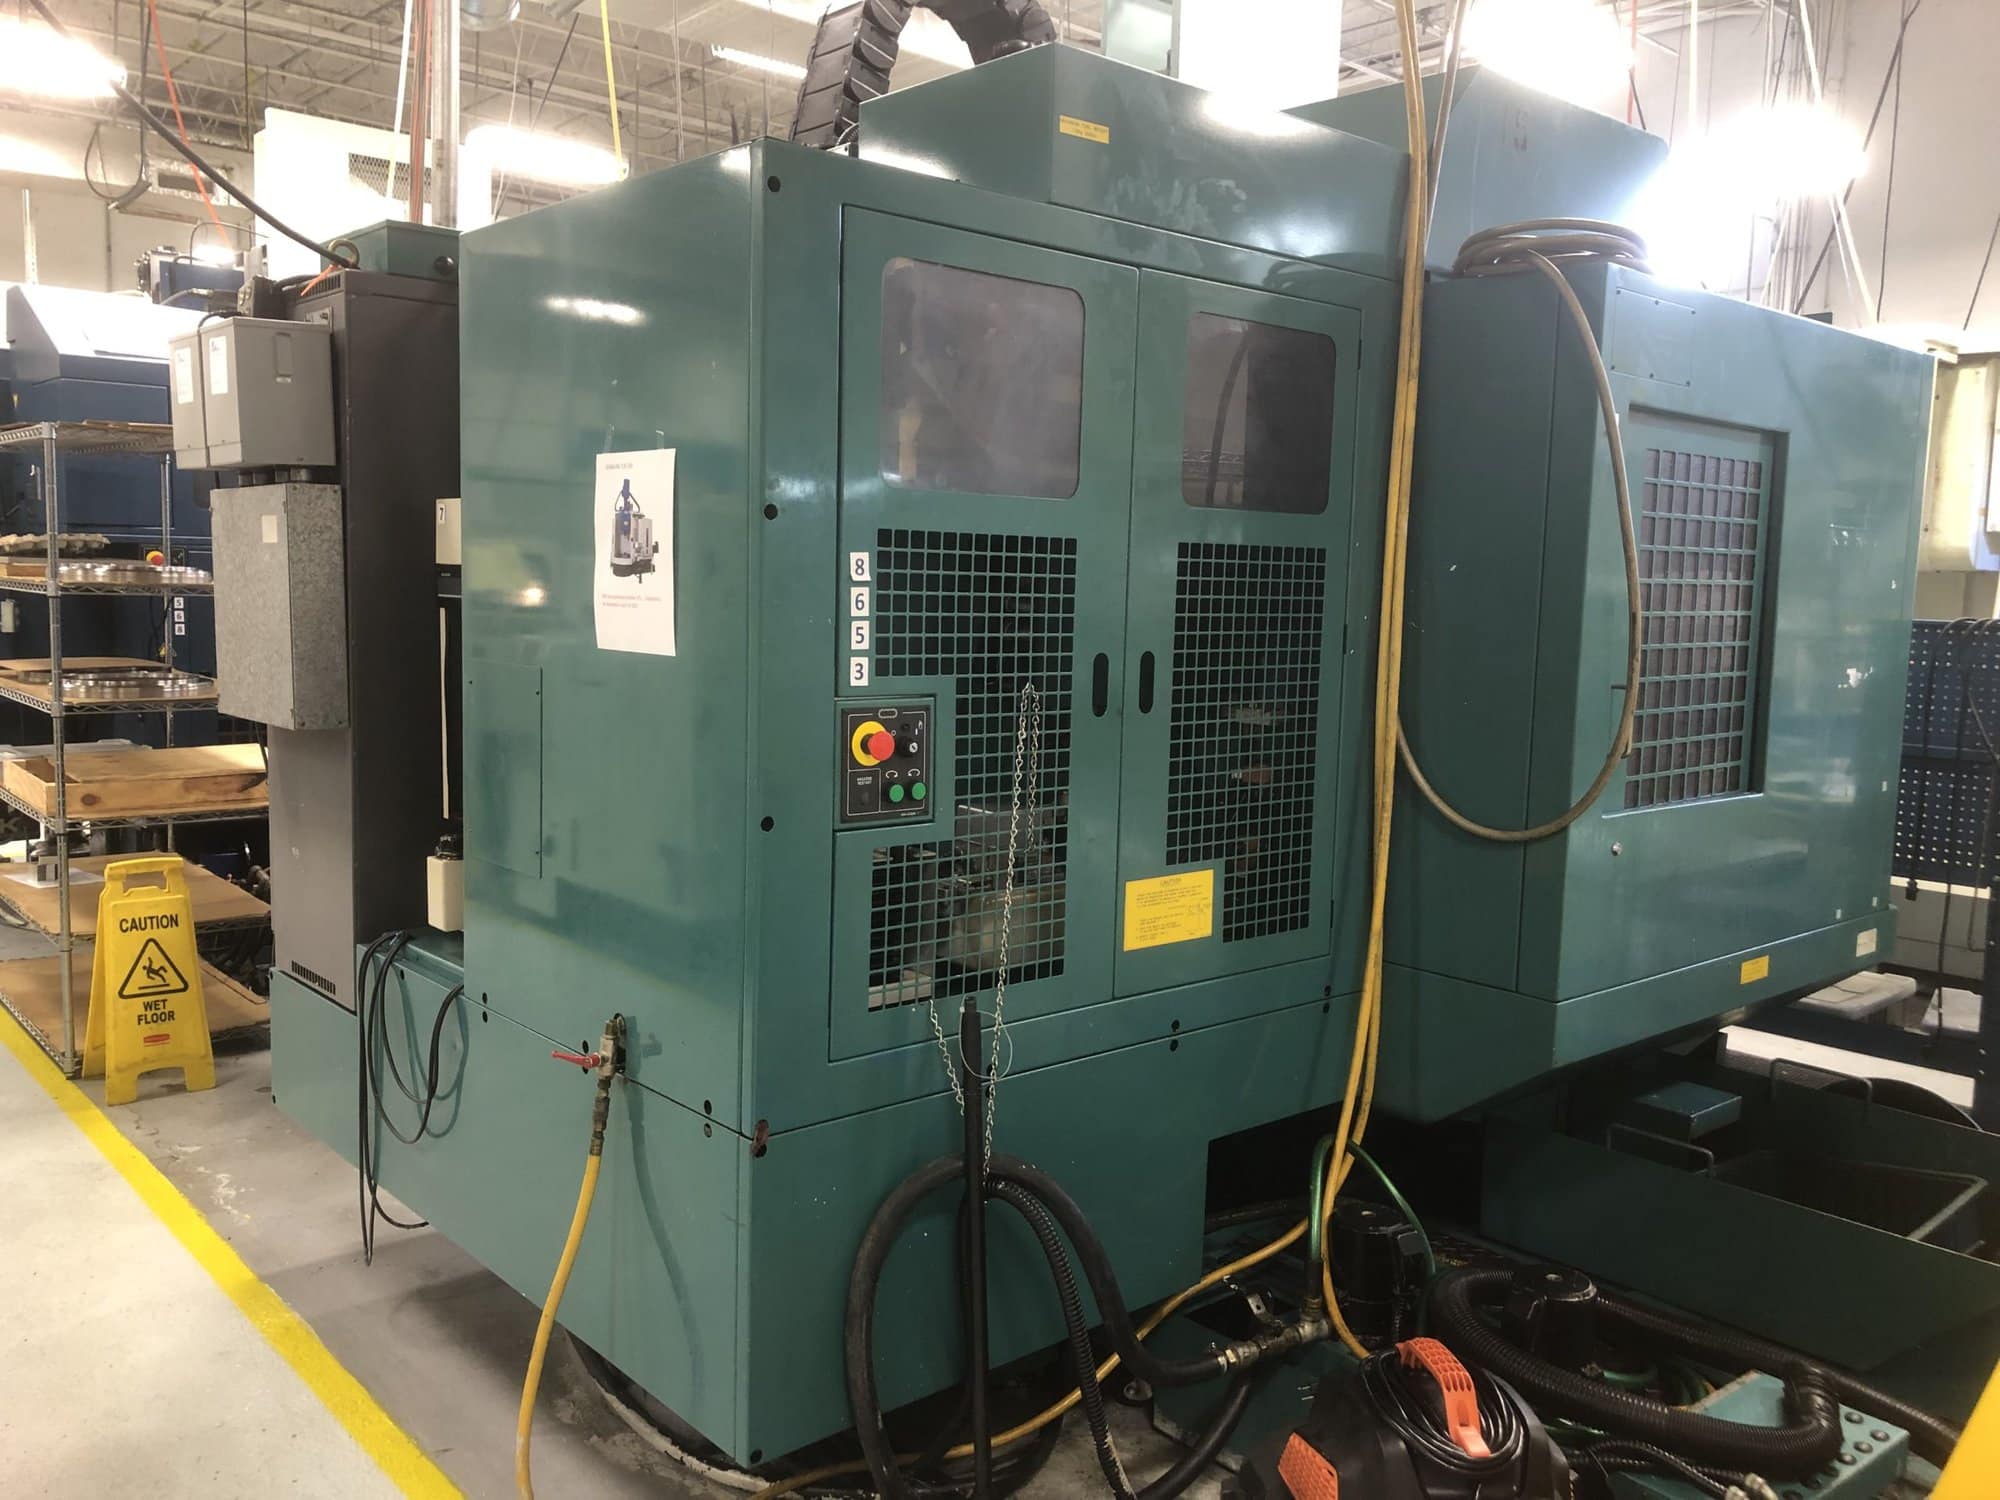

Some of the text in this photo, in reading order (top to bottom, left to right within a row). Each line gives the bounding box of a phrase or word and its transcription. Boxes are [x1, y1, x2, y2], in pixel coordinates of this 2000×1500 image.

[439, 507, 444, 521] 7
[855, 558, 865, 576] 8
[176, 599, 182, 607] 5
[855, 593, 865, 611] 6
[855, 626, 865, 644] 5
[854, 662, 864, 680] 3
[119, 913, 179, 933] CAUTION
[143, 999, 168, 1012] WET
[137, 1010, 175, 1026] FLOOR
